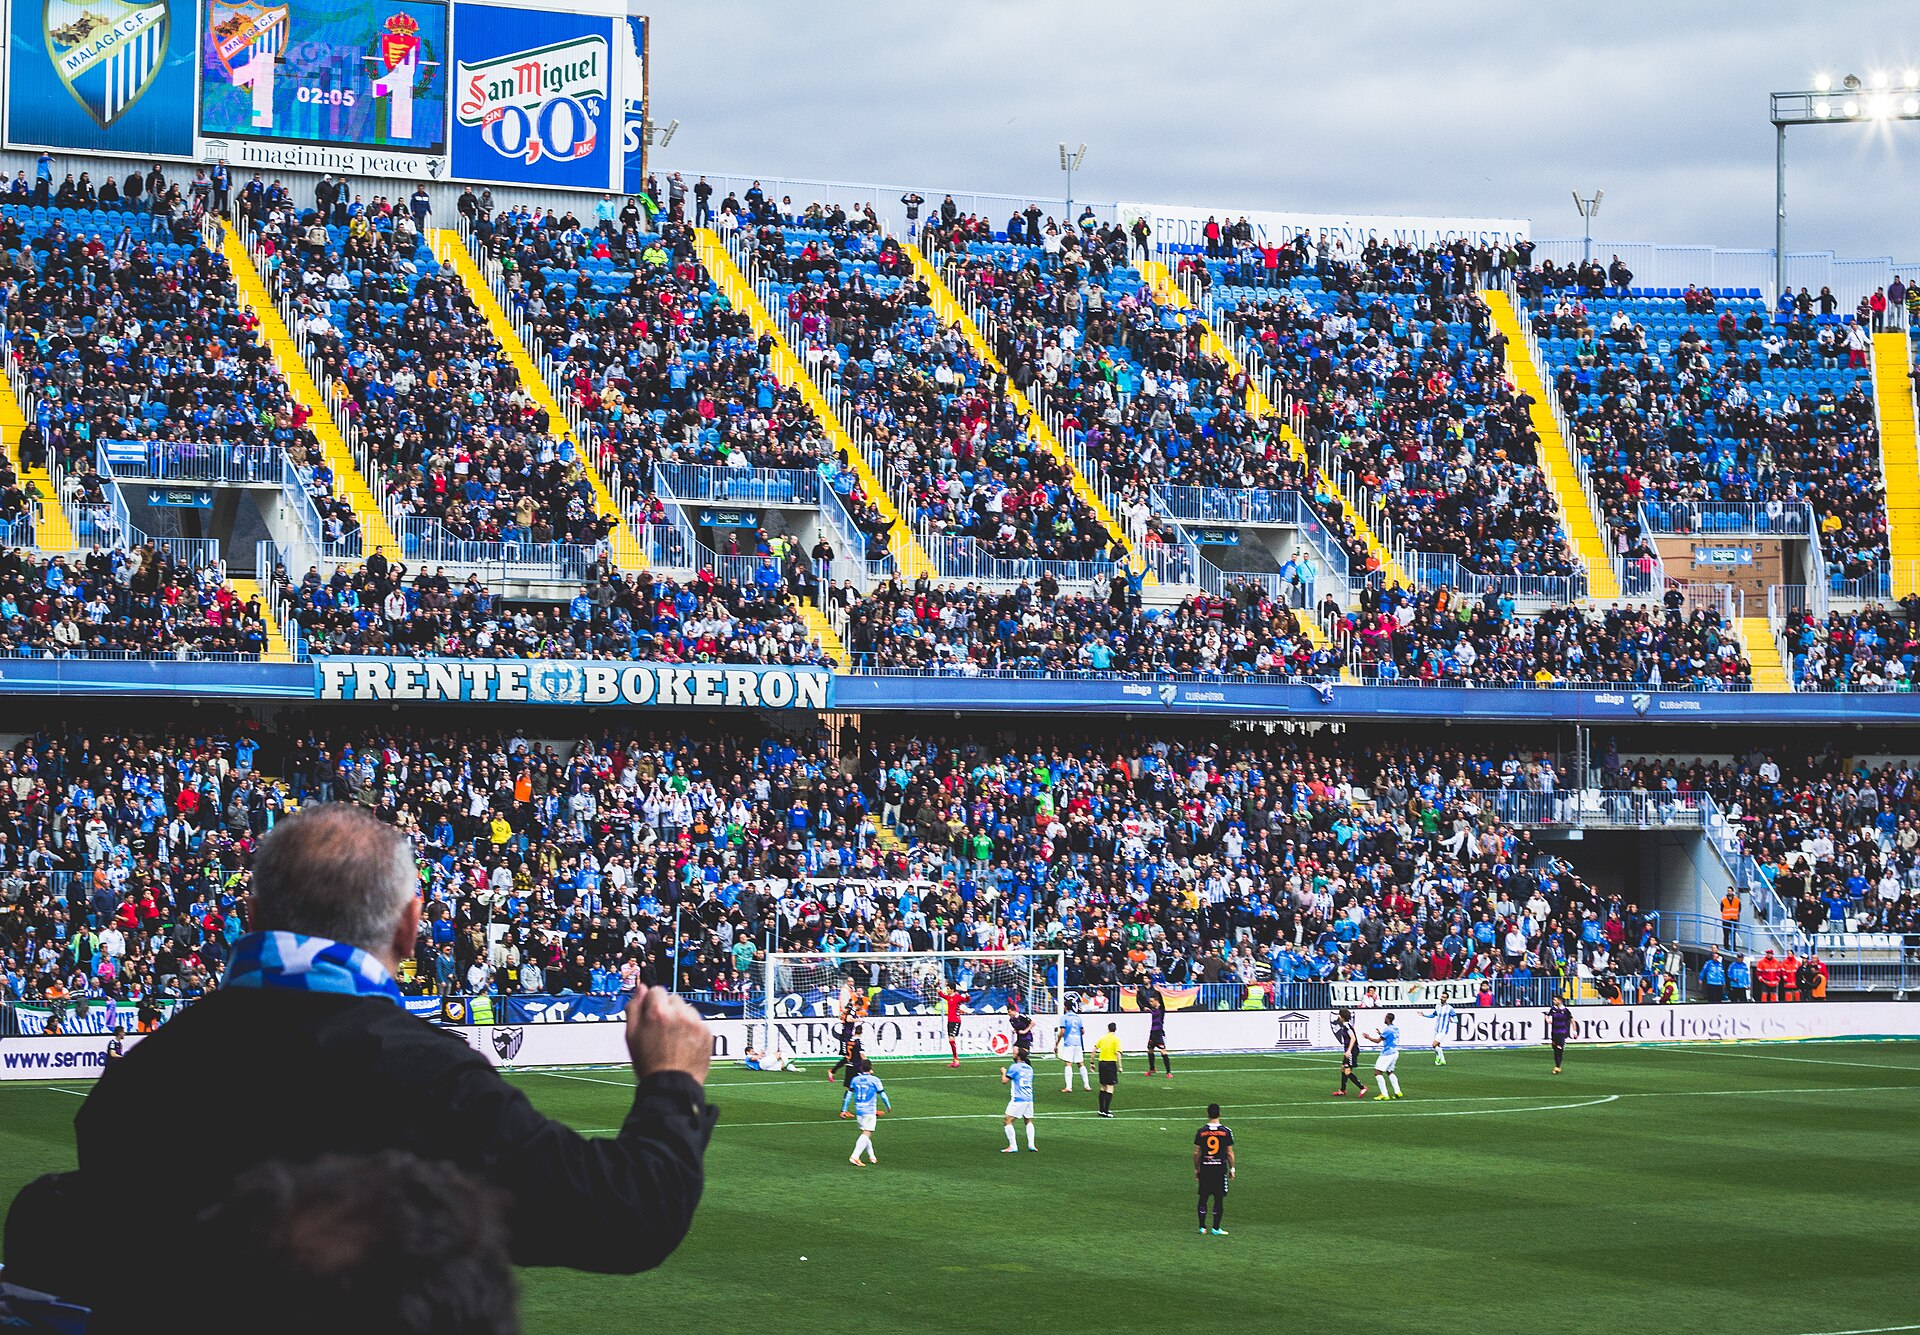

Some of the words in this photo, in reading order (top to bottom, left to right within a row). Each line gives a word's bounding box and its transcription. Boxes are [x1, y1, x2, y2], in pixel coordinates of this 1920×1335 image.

[66, 29, 125, 70] MALAGA
[124, 12, 149, 32] C.F.
[297, 87, 355, 107] 02:05
[372, 46, 416, 139] 1
[461, 73, 514, 114] San
[512, 51, 597, 97] Miguel
[484, 108, 502, 124] SIN
[242, 141, 354, 172] imagining
[360, 155, 418, 174] peace
[168, 491, 192, 501] Salida
[718, 513, 740, 521] Salida
[1204, 531, 1224, 539] Salida
[319, 660, 529, 702] FRENTE
[581, 666, 832, 711] BOKERON
[1453, 1012, 1532, 1041] Estar
[1620, 1010, 1650, 1038] de
[1660, 1009, 1751, 1041] drogas
[1206, 1135, 1220, 1155] 9
